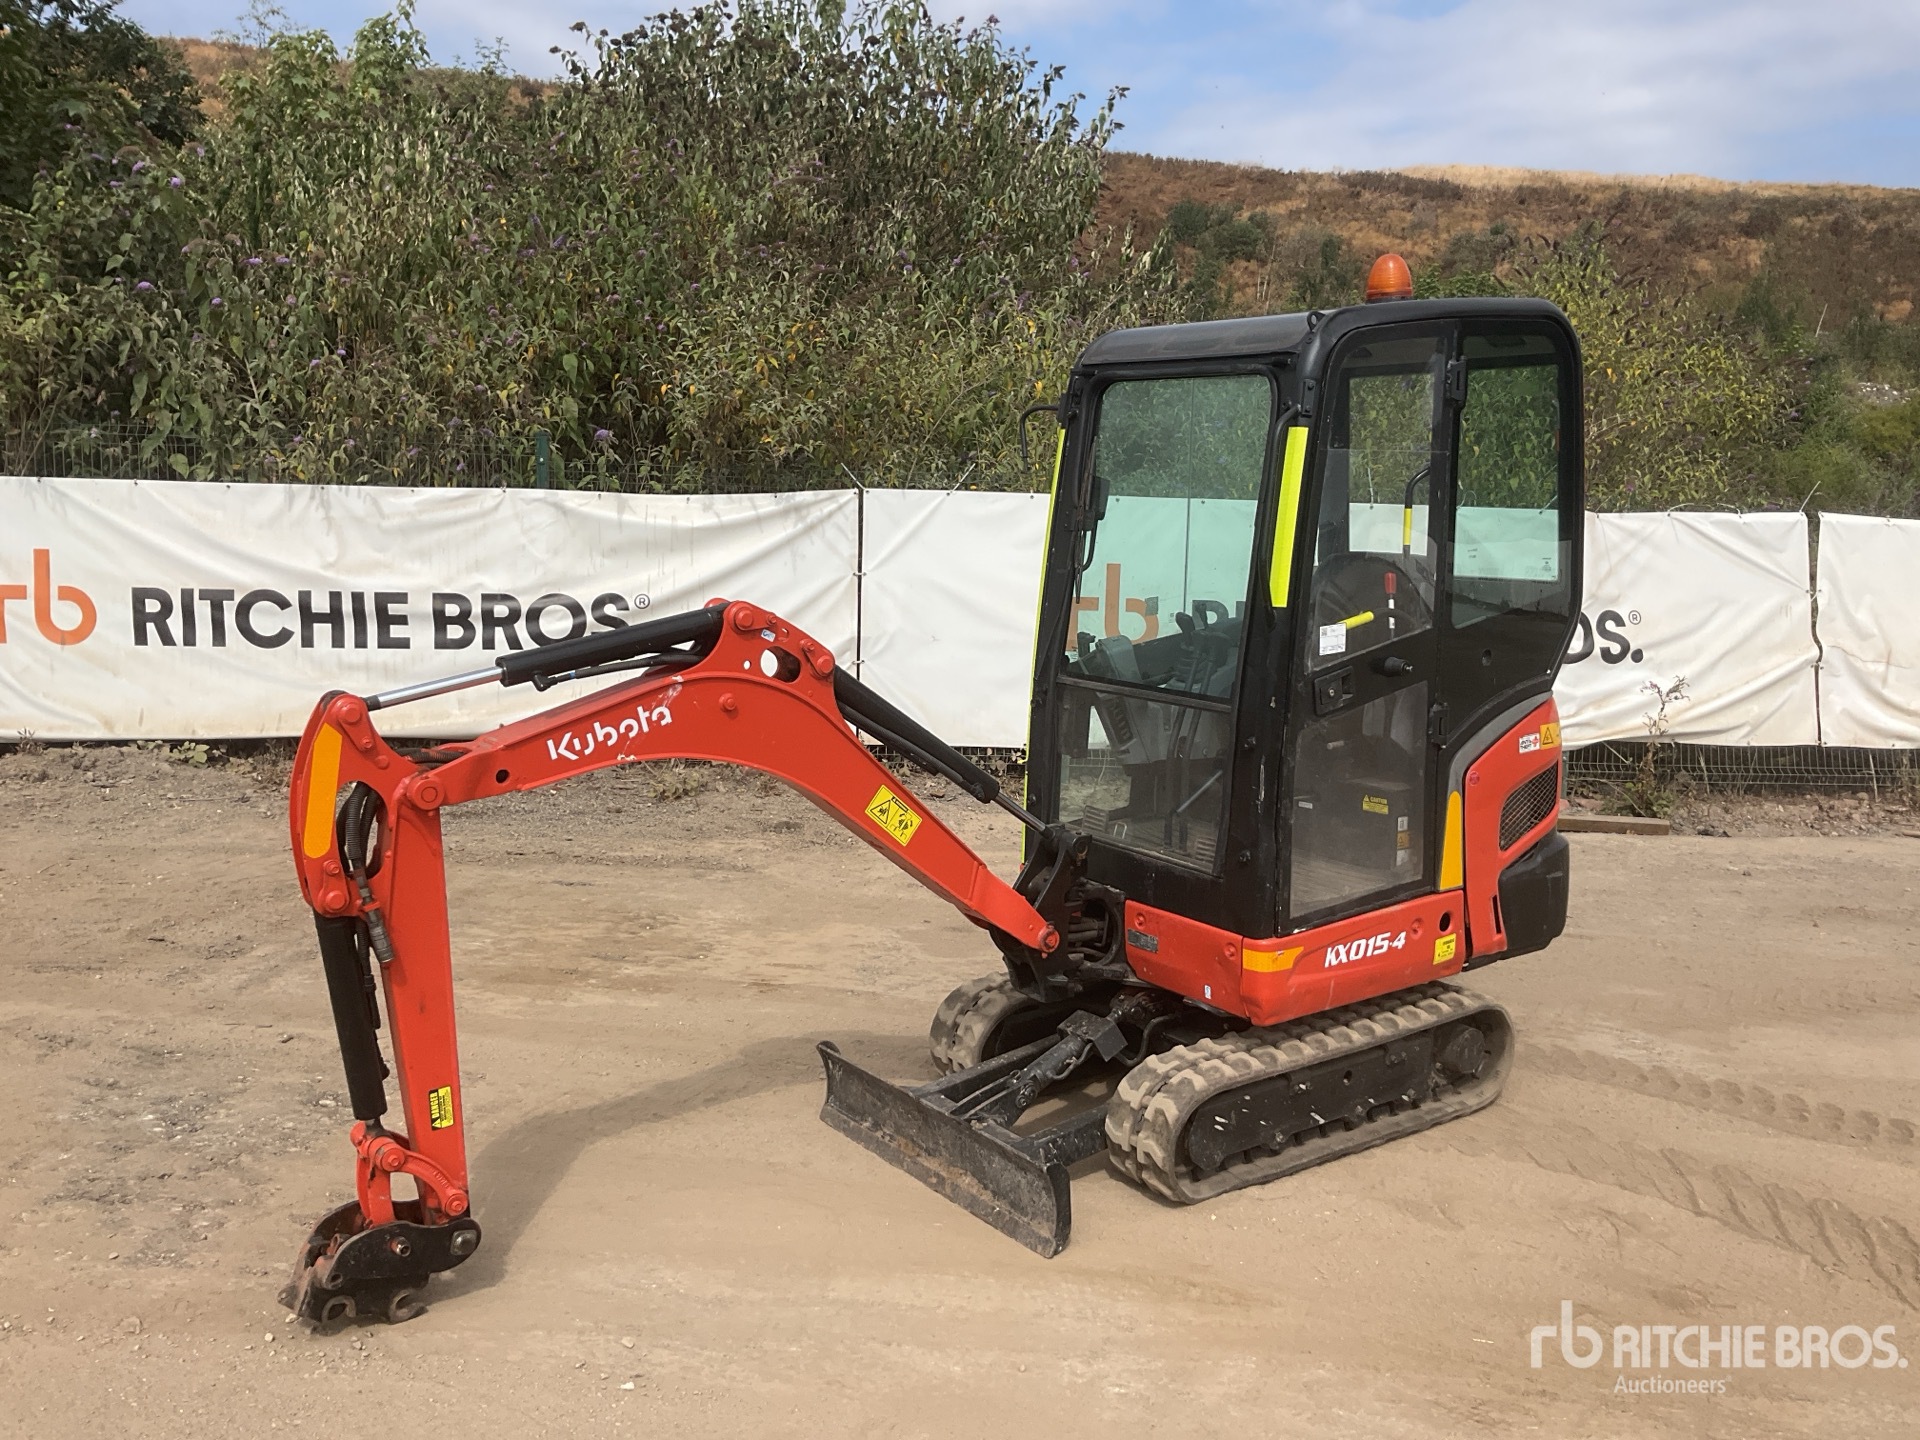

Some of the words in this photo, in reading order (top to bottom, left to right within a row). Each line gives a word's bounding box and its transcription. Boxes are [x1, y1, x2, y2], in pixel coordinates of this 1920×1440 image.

[131, 587, 411, 649] RITCHIE
[546, 705, 673, 761] Kubota
[1324, 931, 1407, 968] KX015-4
[430, 1091, 440, 1119] DANGER
